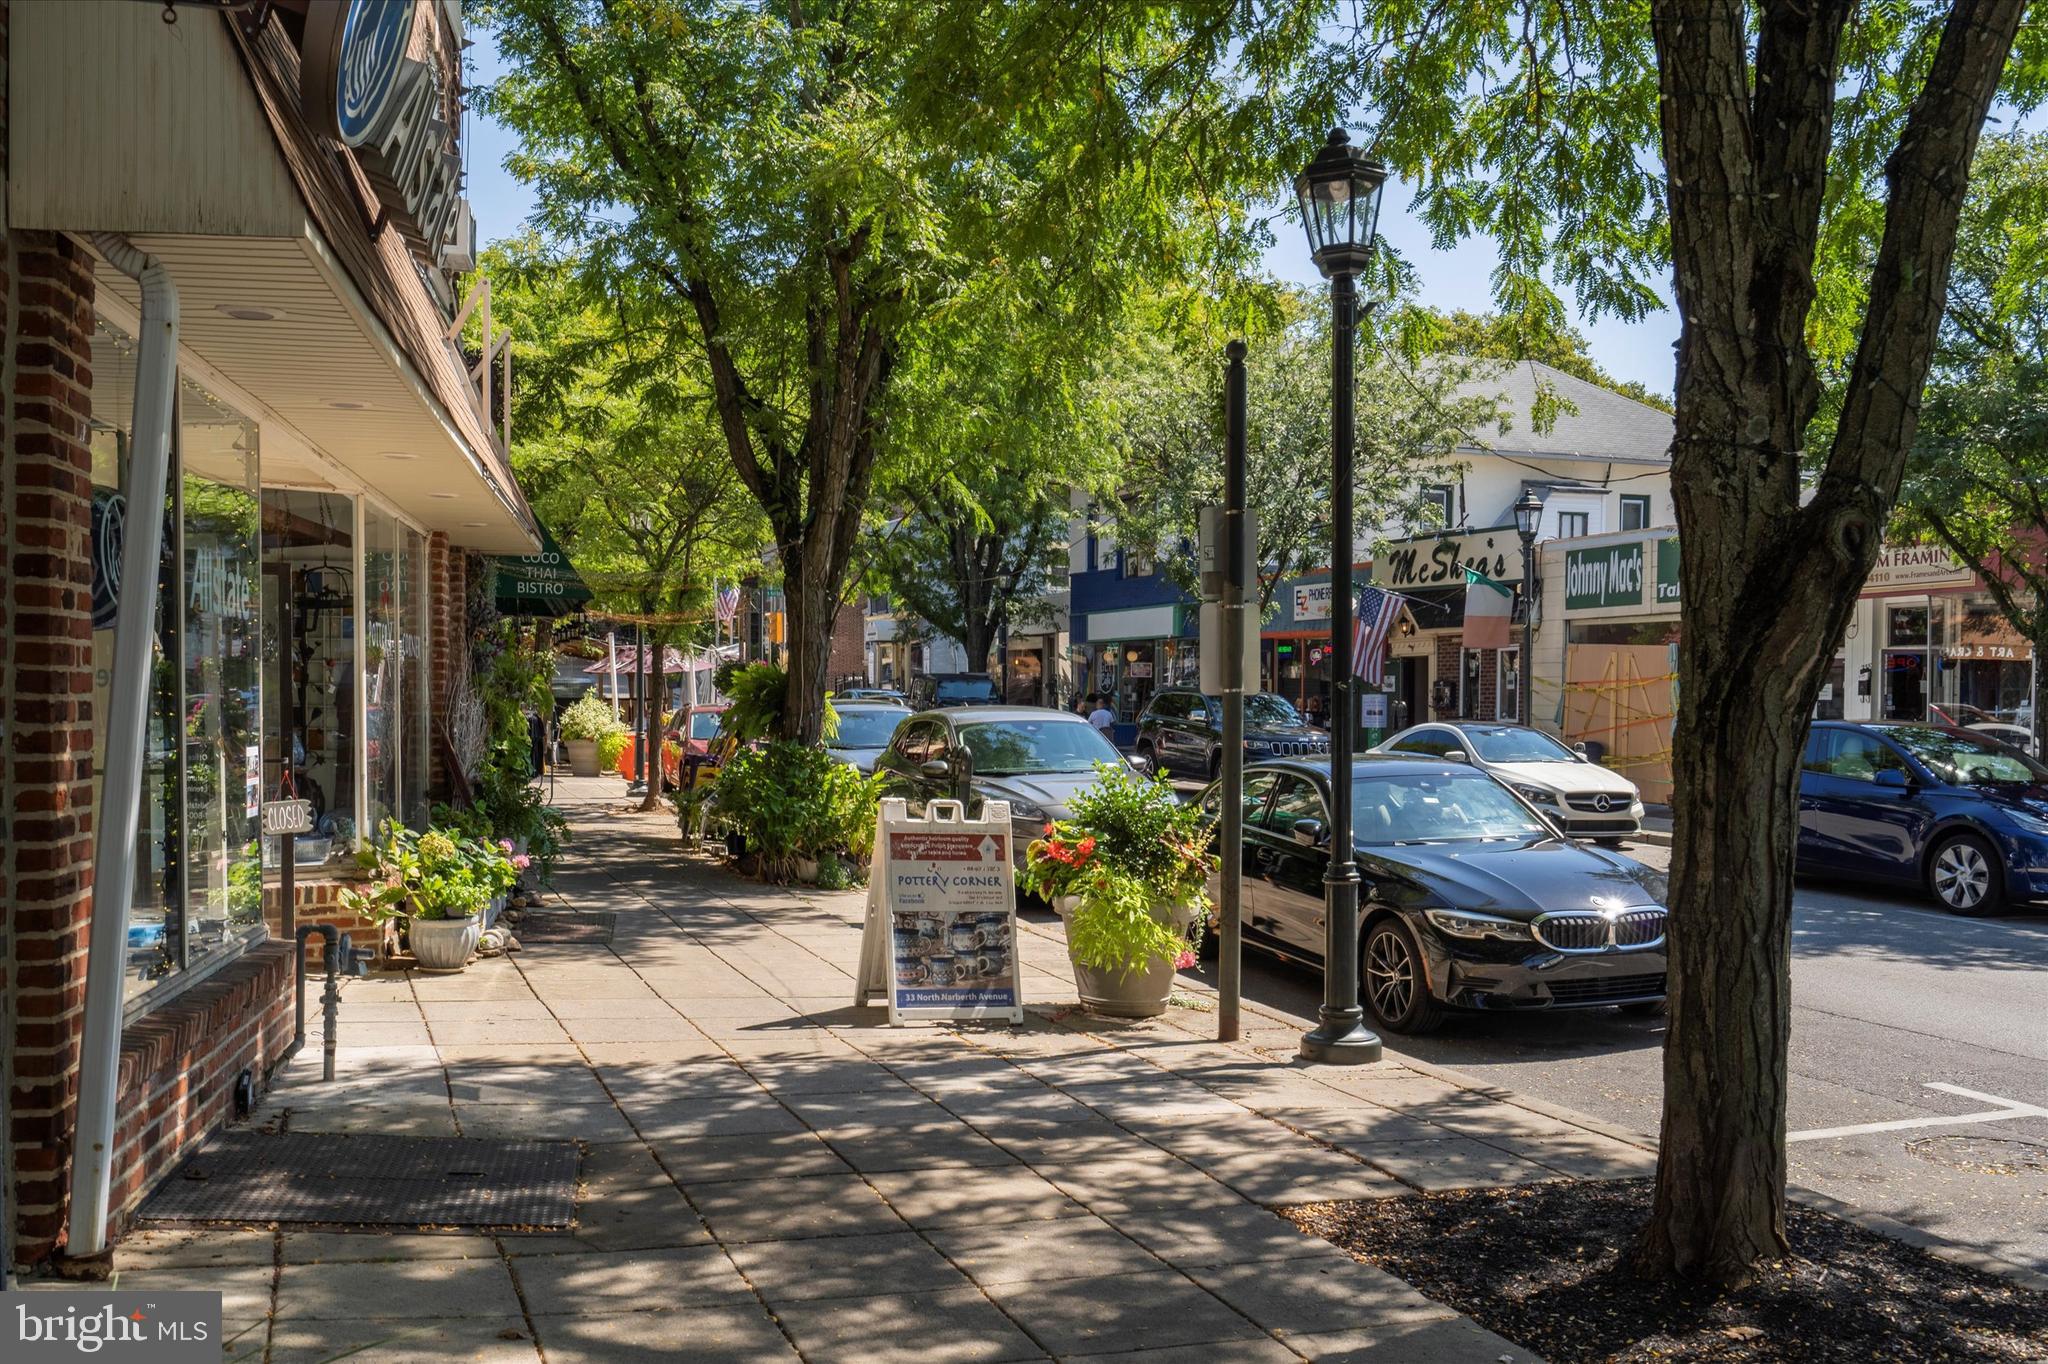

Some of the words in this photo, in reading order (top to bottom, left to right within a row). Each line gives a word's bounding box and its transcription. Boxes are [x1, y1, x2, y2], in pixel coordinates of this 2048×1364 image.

[381, 63, 462, 270] Allstate
[522, 552, 560, 564] COCO
[1894, 549, 1950, 566] FRAMIN
[526, 566, 557, 579] THAI
[1566, 551, 1607, 606] Johnny
[1609, 548, 1642, 594] Mac's
[190, 546, 250, 620] Allstate
[517, 581, 564, 595] BISTRO
[268, 804, 304, 831] CLOSED
[898, 873, 949, 892] POTTERY
[953, 876, 1002, 887] CORNER
[905, 993, 915, 1002] 33
[917, 993, 940, 1001] North
[941, 992, 977, 1001] Narberth
[979, 992, 1008, 1001] Avenue
